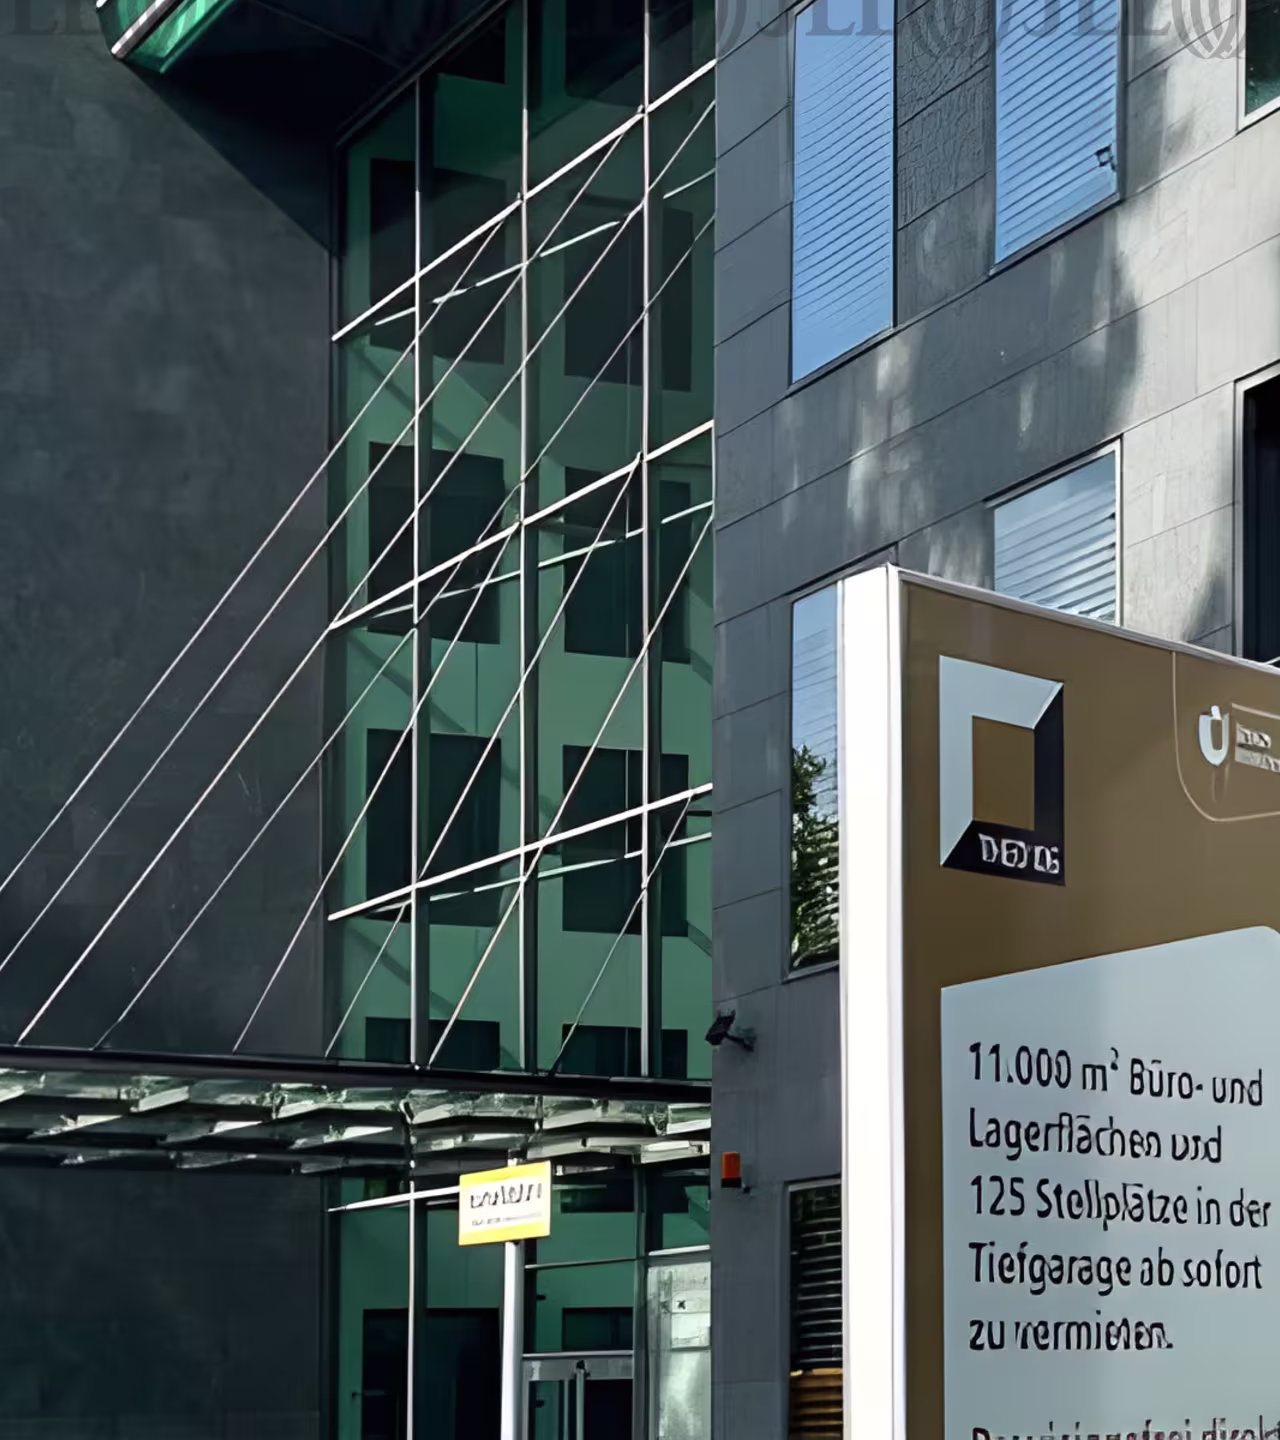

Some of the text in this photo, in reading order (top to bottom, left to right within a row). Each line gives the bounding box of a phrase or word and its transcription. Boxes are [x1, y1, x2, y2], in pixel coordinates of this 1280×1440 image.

[969, 1042, 1072, 1089] 11.000
[1082, 1047, 1119, 1091] m²
[1213, 1068, 1263, 1106] und
[969, 1107, 1222, 1163] Lagerflächen und
[970, 1175, 1271, 1231] 125 Stellplätze in der
[968, 1241, 1262, 1296] Tiefgarage ab sofort
[969, 1320, 1005, 1350] zu
